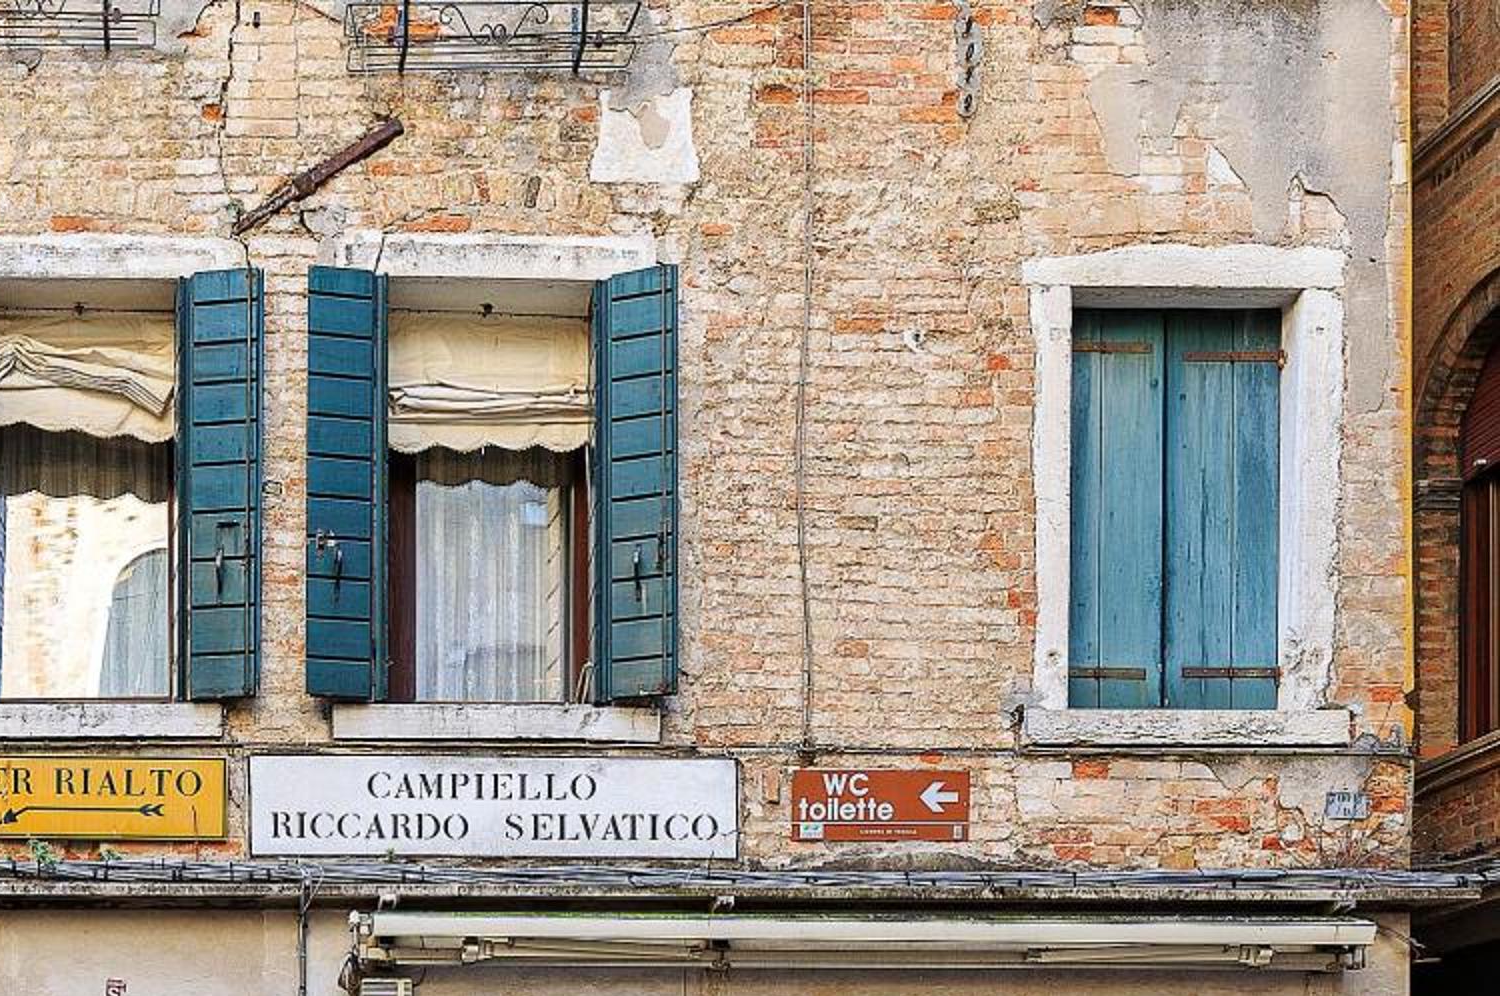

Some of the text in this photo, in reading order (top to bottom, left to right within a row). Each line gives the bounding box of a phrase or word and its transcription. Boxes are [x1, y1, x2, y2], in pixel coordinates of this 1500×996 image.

[55, 768, 202, 797] RIALTO
[367, 771, 597, 800] CAMPIELLO
[822, 773, 869, 797] WC
[799, 797, 894, 821] toilette
[271, 811, 719, 842] RICCARDO SELVATICO
